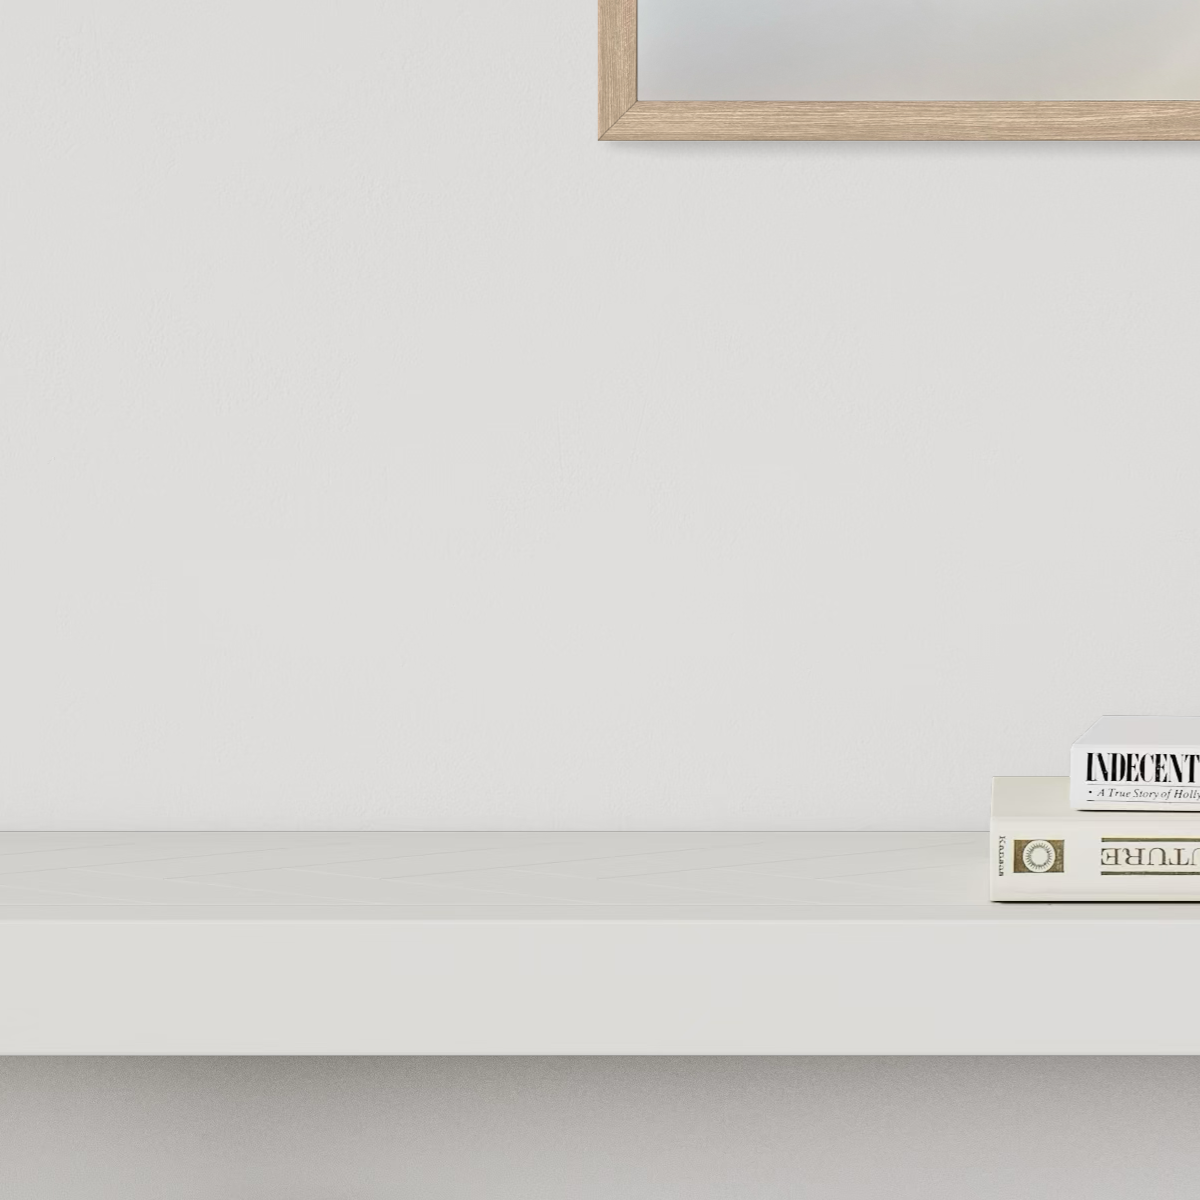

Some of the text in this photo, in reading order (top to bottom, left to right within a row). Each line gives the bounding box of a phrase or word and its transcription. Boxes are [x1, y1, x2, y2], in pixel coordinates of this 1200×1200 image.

[1086, 753, 1200, 783] INDECENT
[1096, 788, 1105, 798] A
[1108, 788, 1130, 798] True
[1133, 789, 1159, 800] Story
[1160, 789, 1172, 800] of
